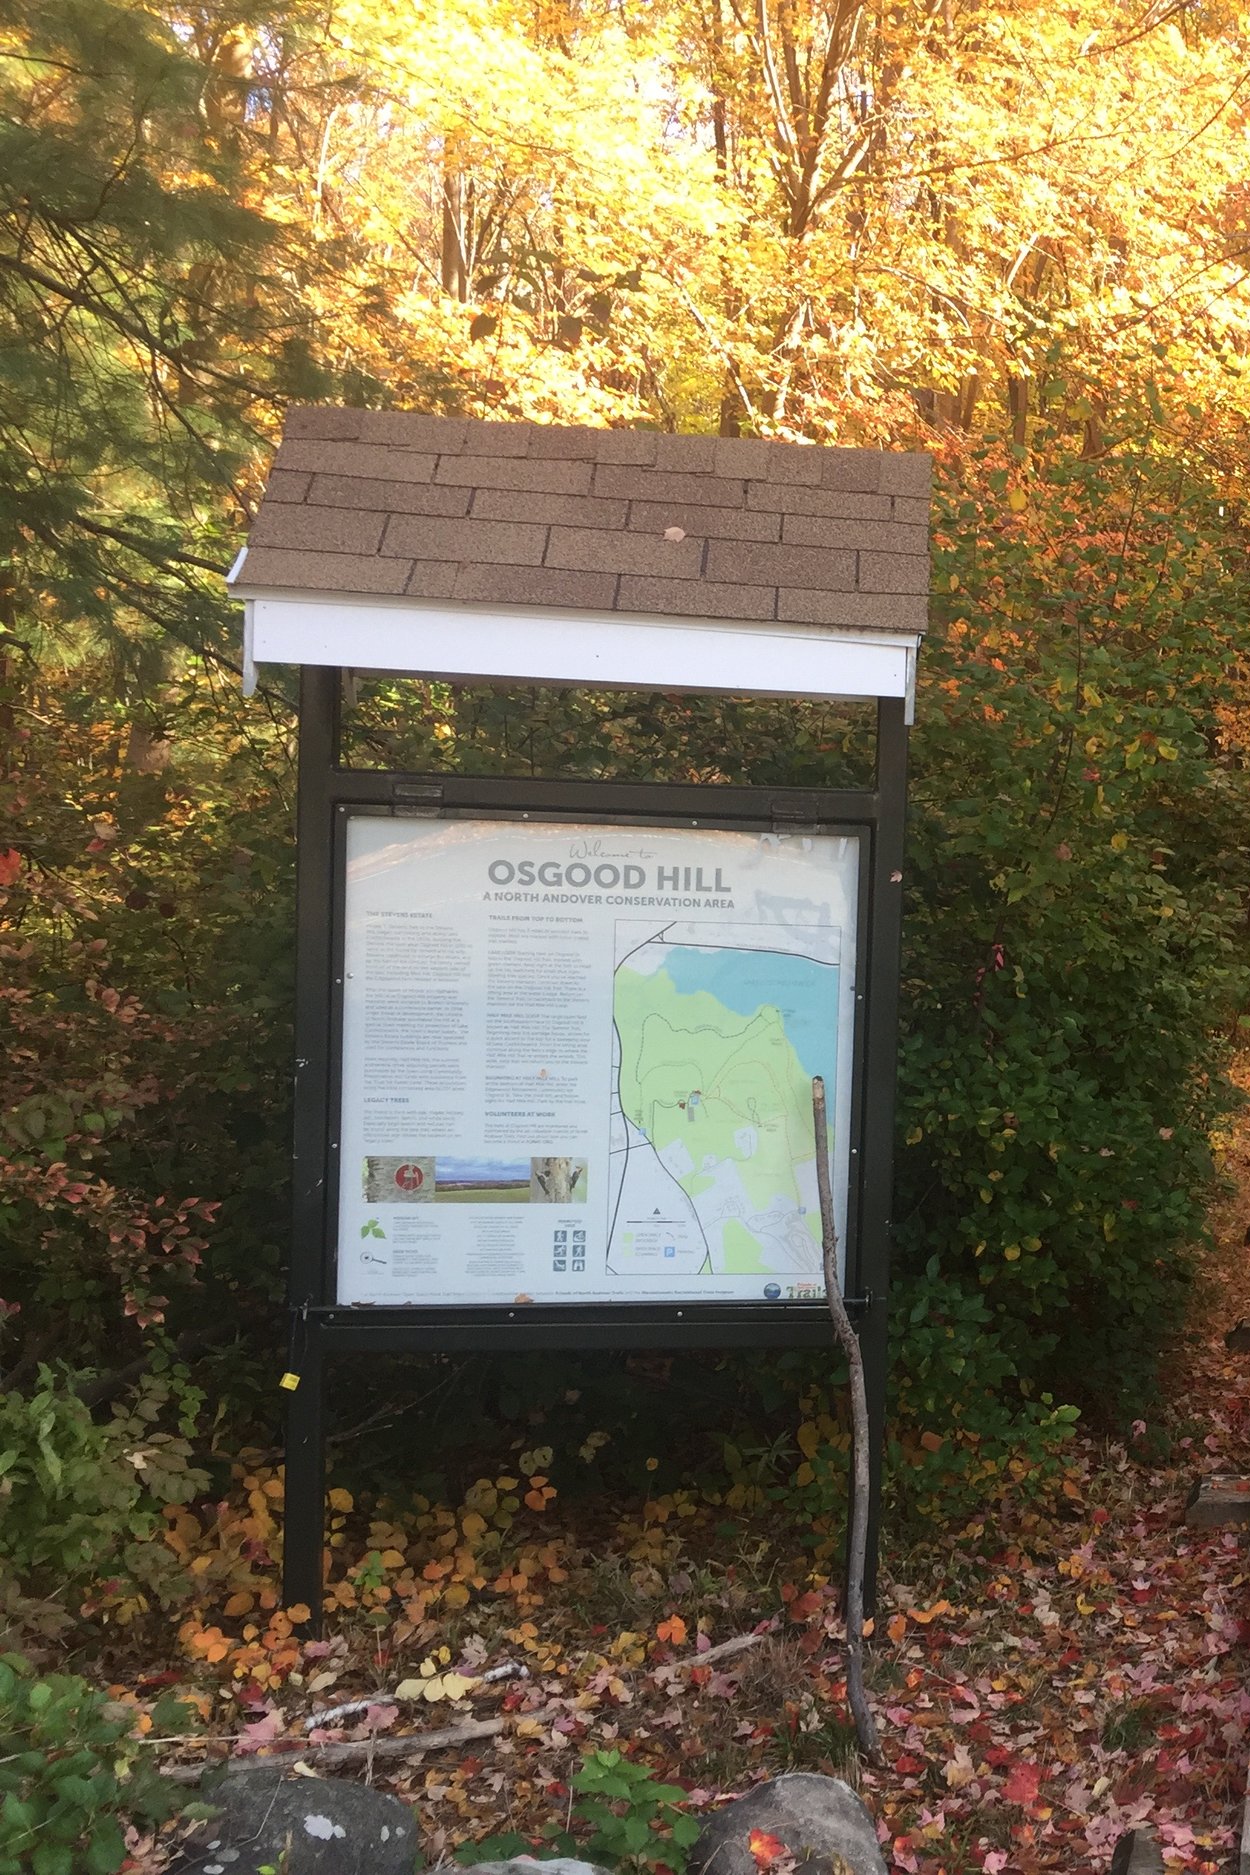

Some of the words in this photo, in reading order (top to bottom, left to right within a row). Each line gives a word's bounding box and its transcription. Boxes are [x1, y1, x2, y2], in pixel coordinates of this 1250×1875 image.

[569, 840, 631, 859] Welcome
[631, 848, 658, 859] to
[488, 859, 646, 889] OSGOOD
[657, 865, 732, 893] HILL
[483, 892, 491, 901] A
[494, 892, 539, 903] NORTH
[542, 893, 602, 905] ANDOVER
[605, 895, 701, 908] CONSERVATION
[703, 899, 735, 909] AREA
